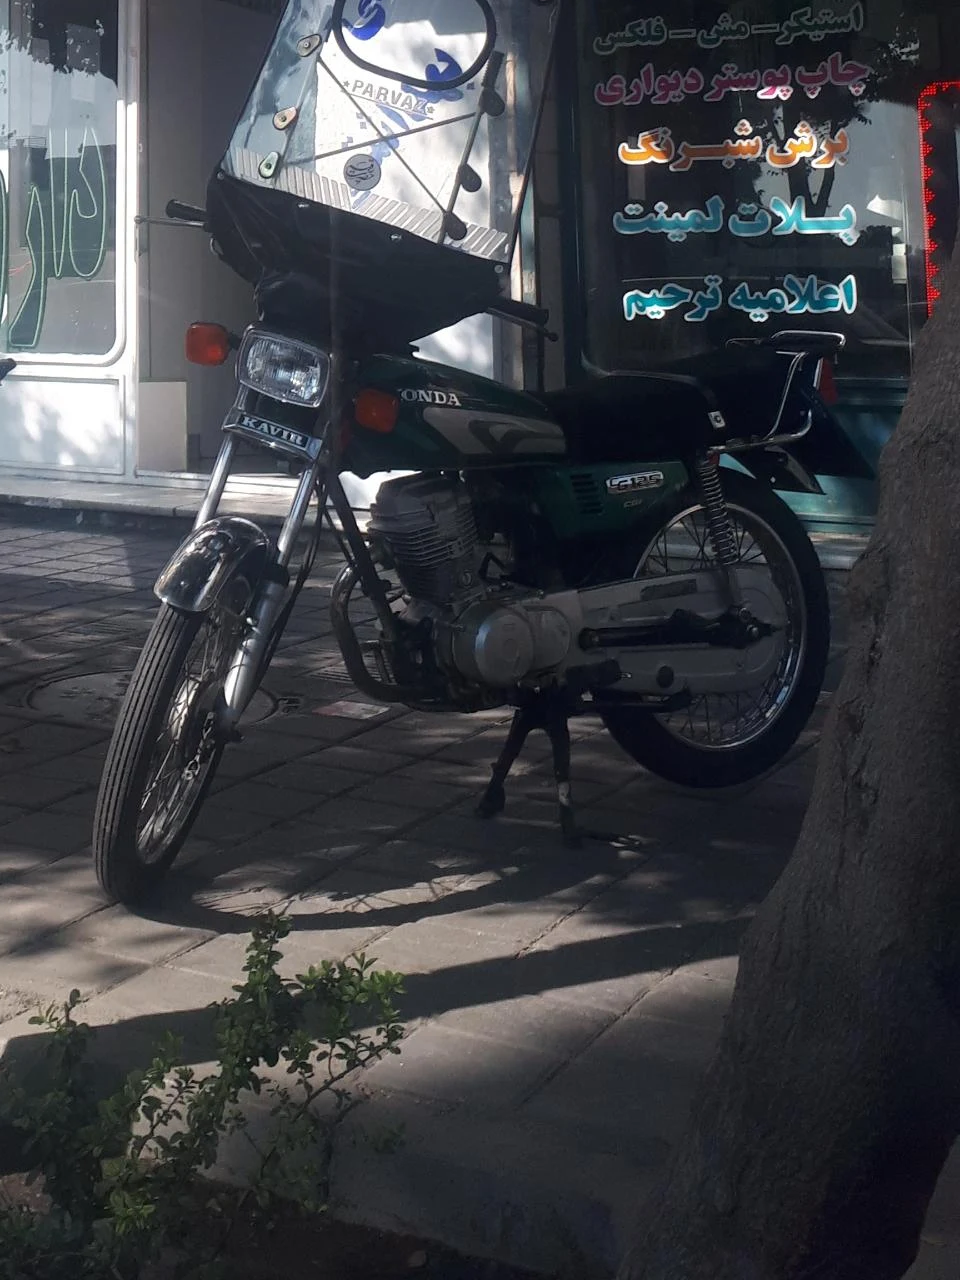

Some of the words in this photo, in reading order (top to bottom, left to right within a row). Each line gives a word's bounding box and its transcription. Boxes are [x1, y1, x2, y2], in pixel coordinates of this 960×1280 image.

[351, 78, 428, 115] PARVAZ
[594, 62, 705, 106] دیواری
[703, 63, 794, 103] پوستر
[794, 51, 874, 100] چاپ
[618, 118, 763, 172] شبرنگ
[765, 120, 850, 169] برش
[612, 194, 726, 243] لمینت
[727, 195, 861, 246] پلات
[622, 274, 723, 322] ترحیم
[727, 273, 858, 323] اعلامیه
[398, 387, 462, 408] ONDA
[241, 414, 305, 447] KAVIR
